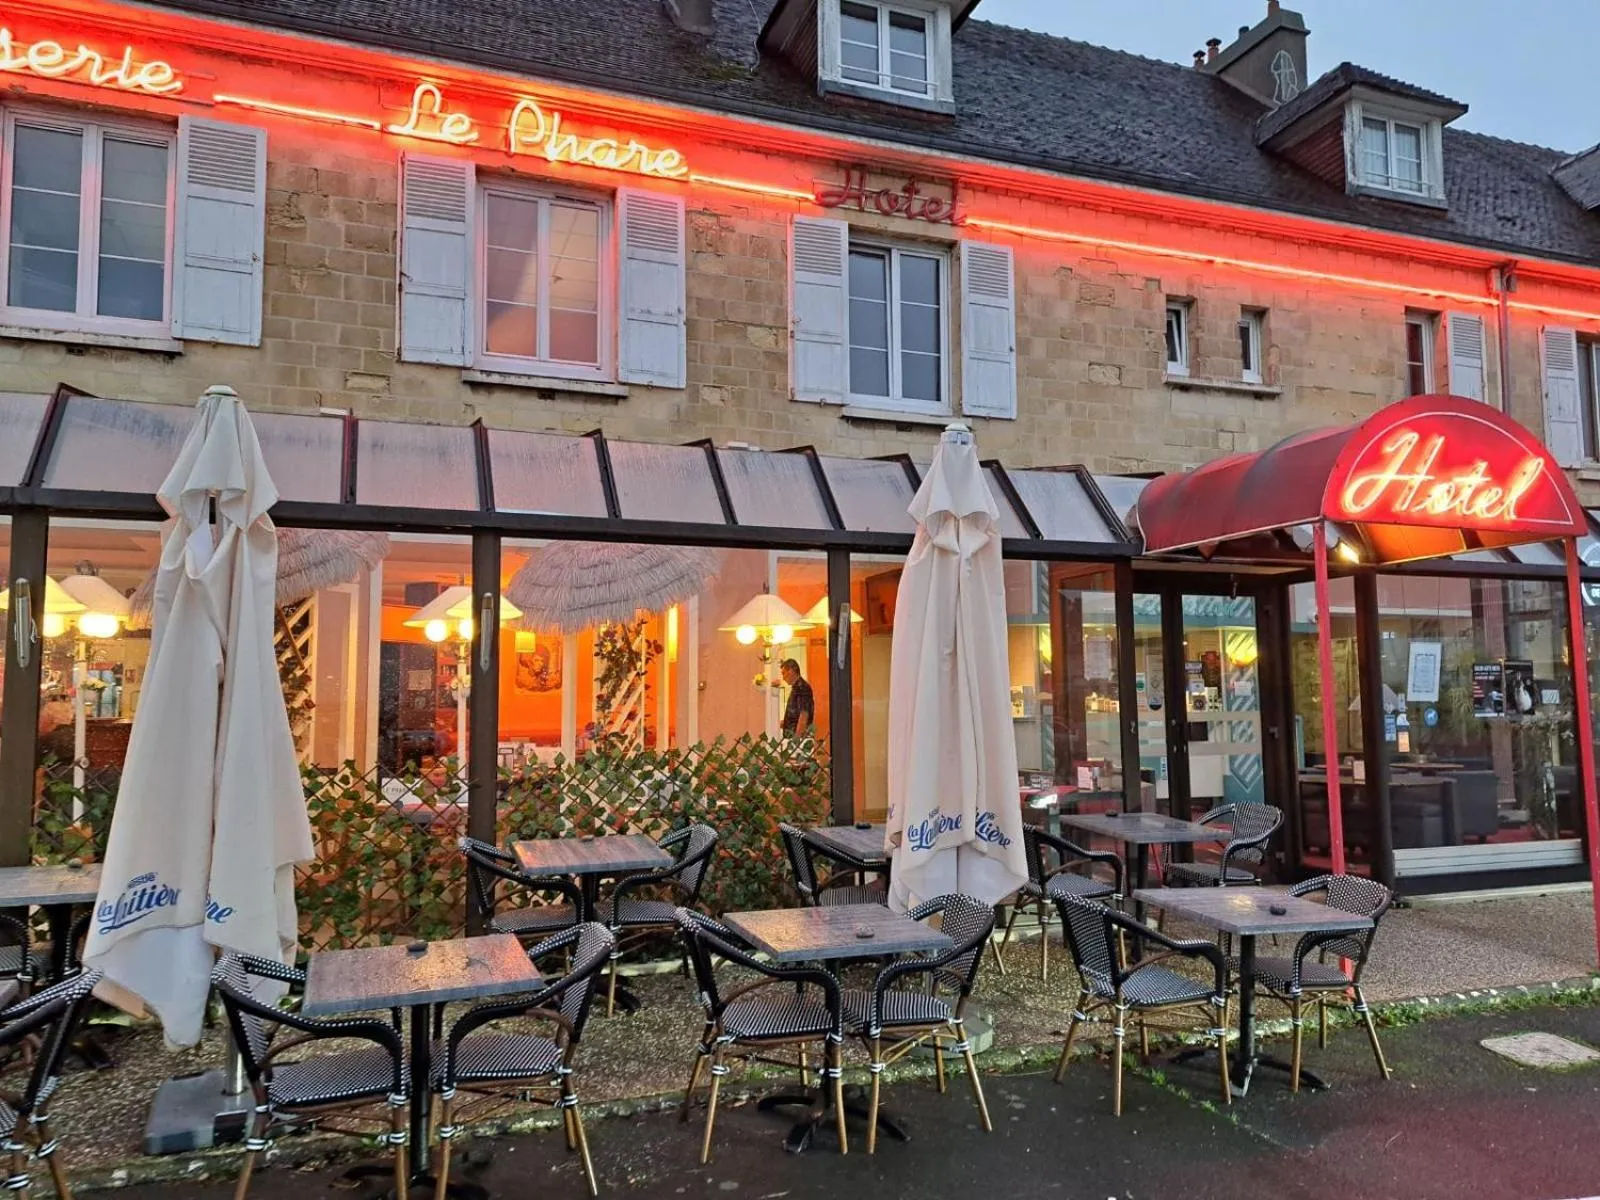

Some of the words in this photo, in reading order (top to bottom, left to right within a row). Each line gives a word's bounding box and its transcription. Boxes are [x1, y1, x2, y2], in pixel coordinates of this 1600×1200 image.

[387, 82, 479, 143] Le
[508, 98, 689, 177] Phare
[814, 162, 967, 226] Hotel
[1343, 431, 1545, 520] Hotel
